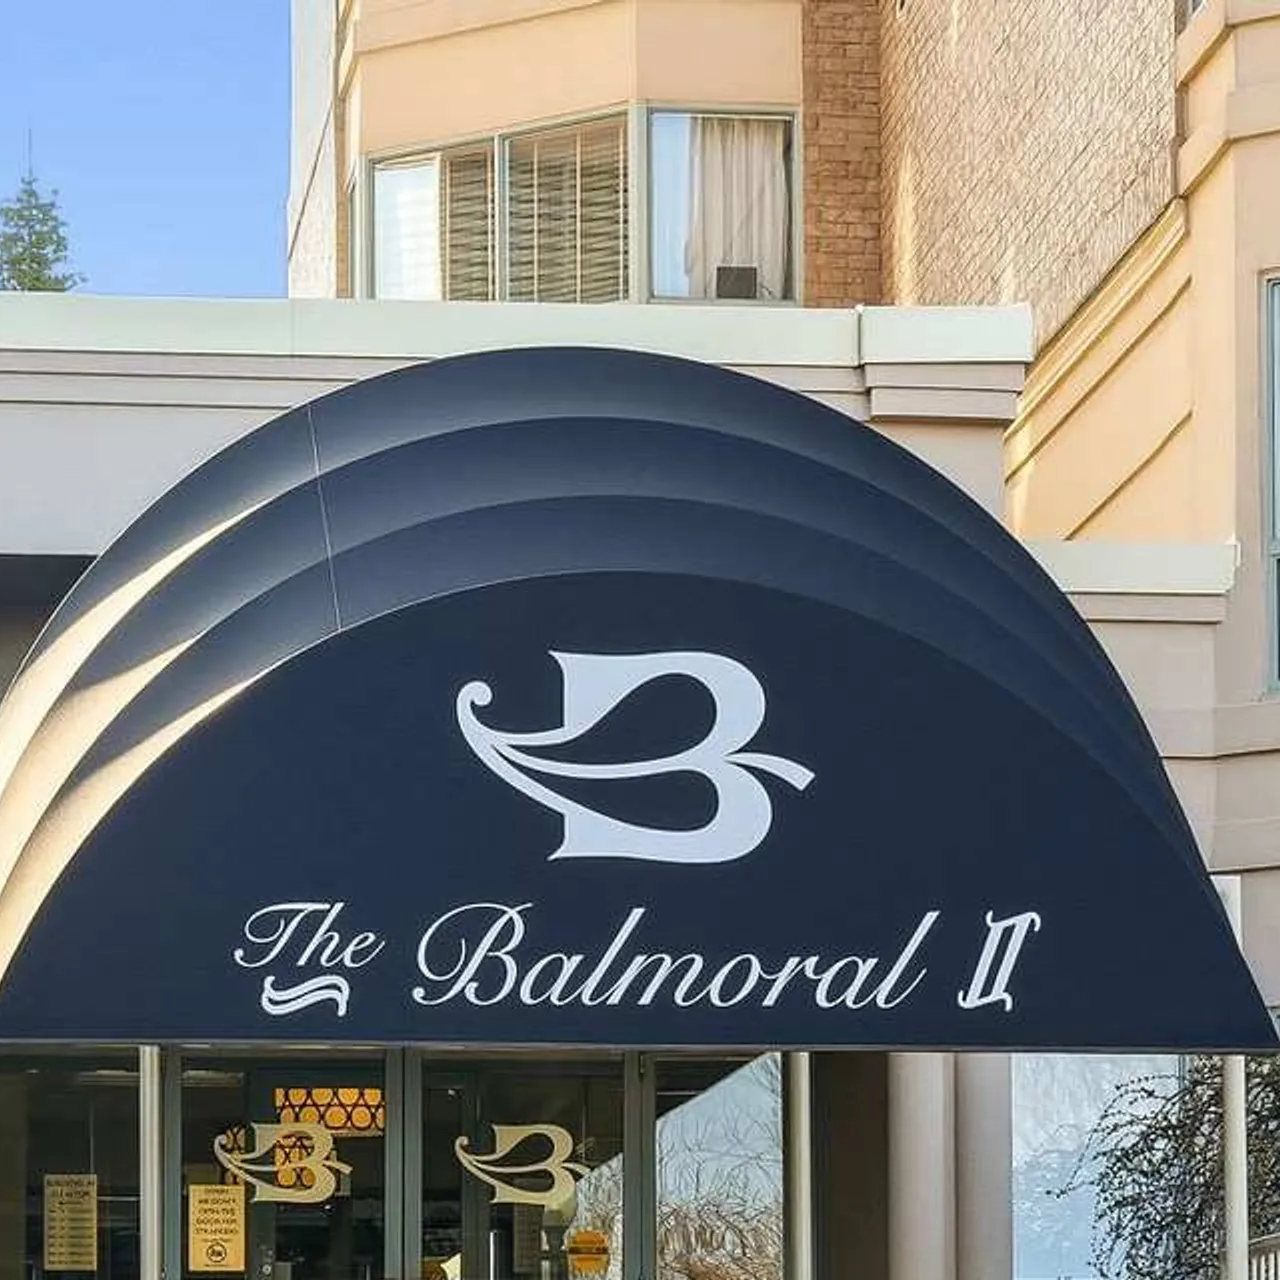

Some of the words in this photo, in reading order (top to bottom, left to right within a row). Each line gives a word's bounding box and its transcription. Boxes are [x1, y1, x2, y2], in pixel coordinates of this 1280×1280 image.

[457, 650, 815, 863] B
[234, 902, 385, 970] The
[412, 903, 940, 1009] Balmoral
[958, 910, 1041, 1011] II
